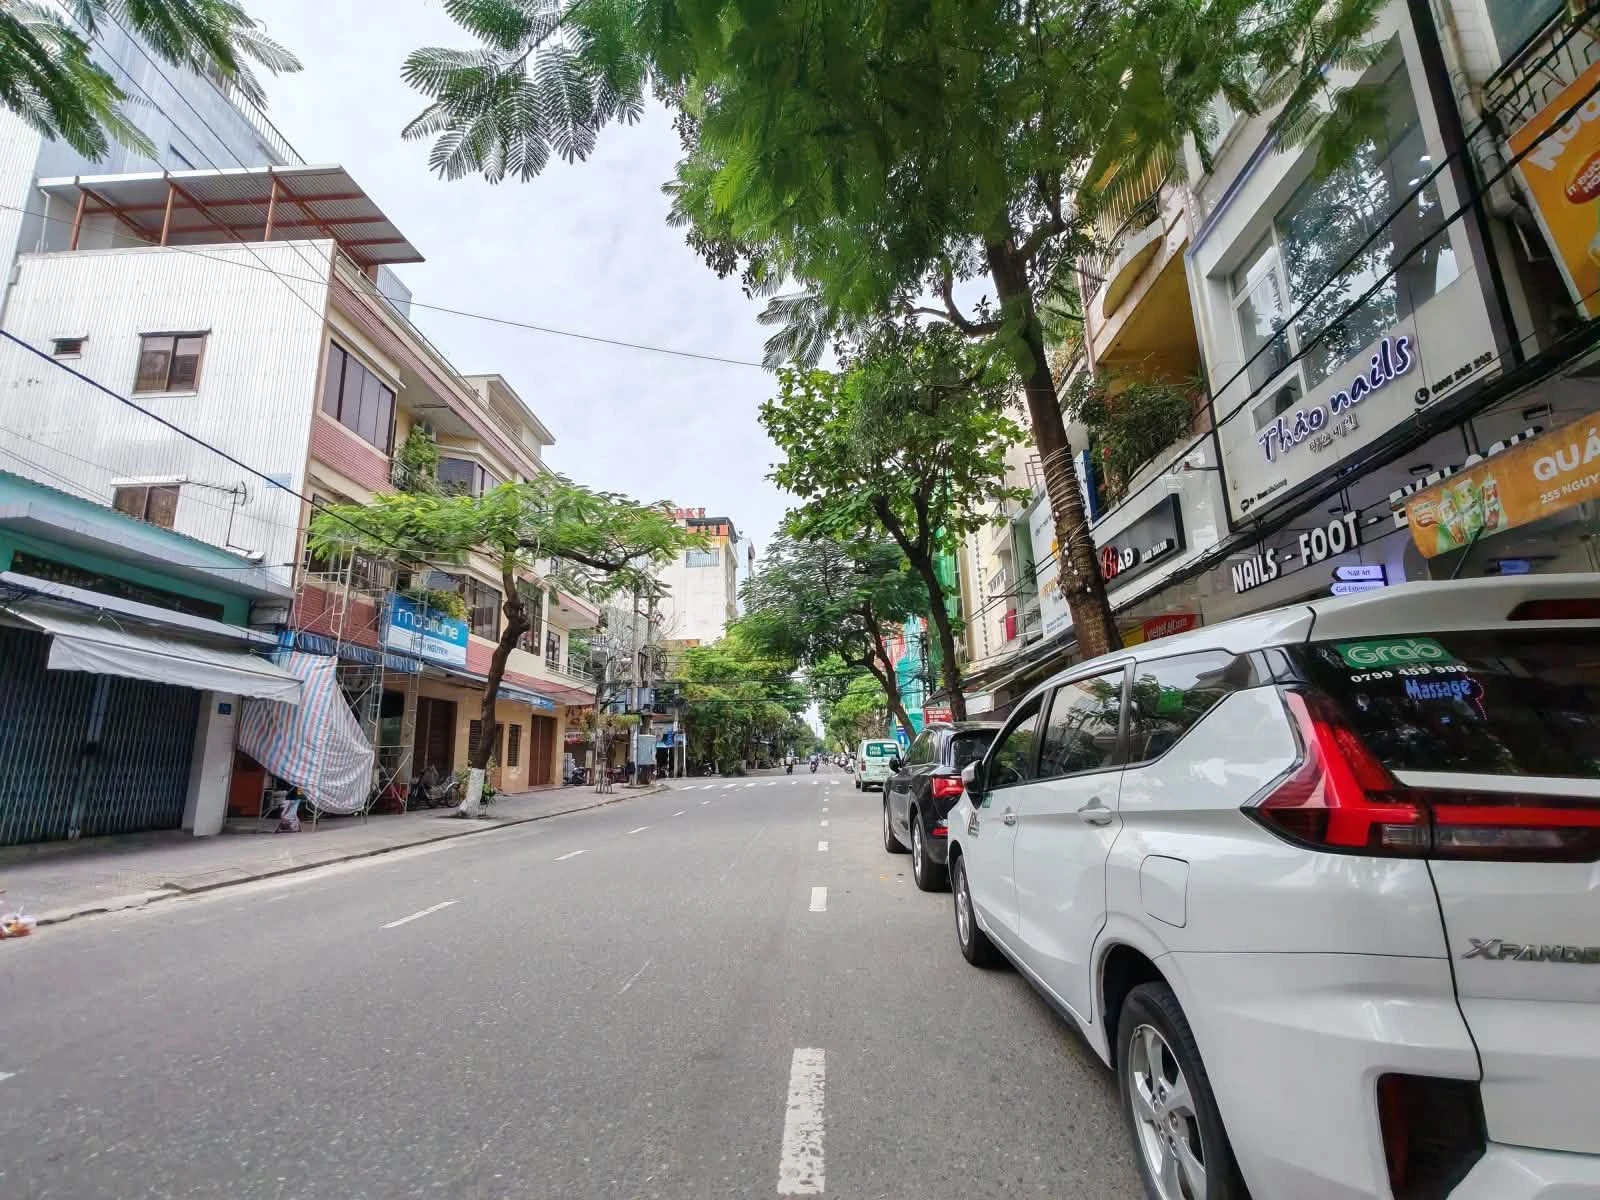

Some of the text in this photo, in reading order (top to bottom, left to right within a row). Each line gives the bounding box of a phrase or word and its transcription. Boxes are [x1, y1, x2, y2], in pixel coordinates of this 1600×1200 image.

[1526, 80, 1600, 172] NGO
[1329, 335, 1413, 415] nails
[1540, 488, 1561, 505] 255
[1231, 510, 1361, 594] NAILS FOOT
[1347, 639, 1443, 664] Grab
[1350, 664, 1469, 683] 0799 459 990
[1405, 679, 1473, 701] Massage
